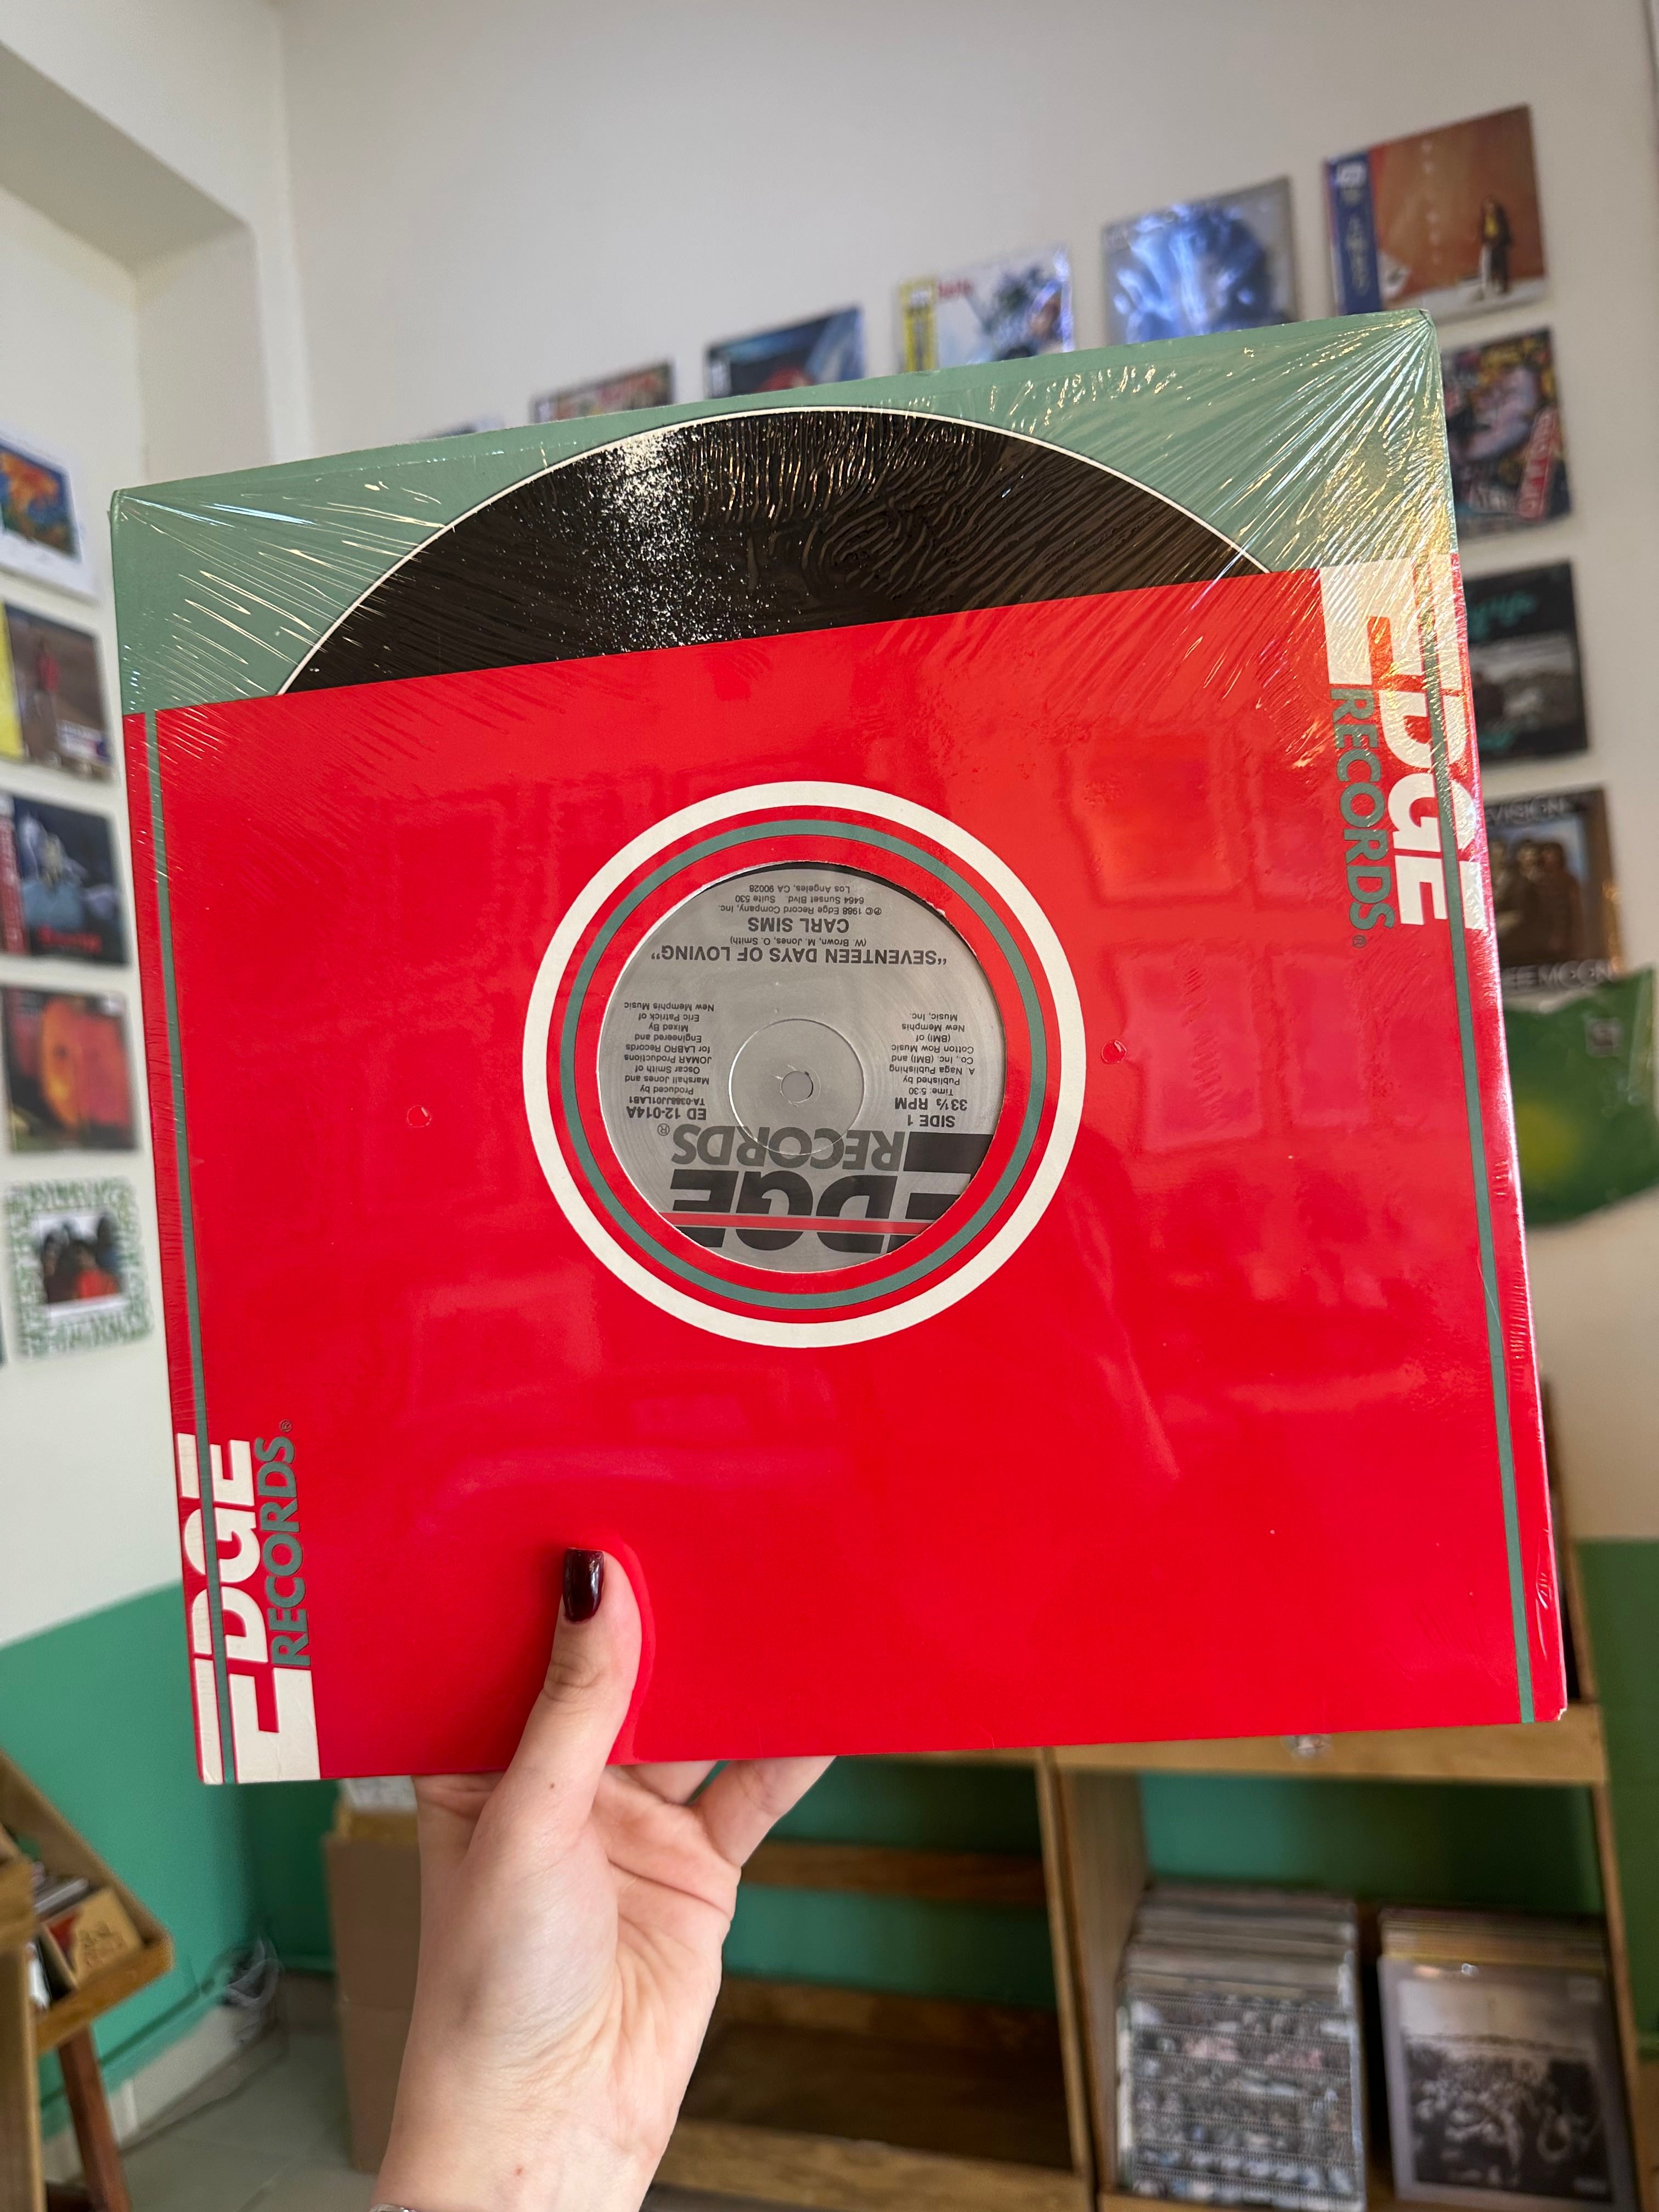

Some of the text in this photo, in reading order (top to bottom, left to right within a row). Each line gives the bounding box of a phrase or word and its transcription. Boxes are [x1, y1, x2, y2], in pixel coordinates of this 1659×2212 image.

[1319, 553, 1488, 931] EDGE
[793, 884, 831, 893] Angeles,
[737, 904, 780, 913] Company,
[783, 906, 814, 914] Record
[817, 905, 839, 915] Edge
[747, 917, 849, 933] CARL SIMS
[730, 936, 758, 945] Smith)
[774, 937, 802, 946] Jones,
[820, 937, 849, 947] Brown,
[853, 938, 867, 947] (W.
[651, 945, 947, 966] “SEVENTEEN DAYS OF LOVING”
[653, 1002, 692, 1011] Memphis
[929, 1012, 958, 1022] Music,
[648, 1022, 659, 1031] By
[902, 1023, 941, 1031] Memphis
[654, 1034, 702, 1042] Engineered
[927, 1034, 950, 1042] (BMI)
[625, 1044, 661, 1052] Records
[664, 1045, 696, 1053] LABRO
[624, 1054, 712, 1064] JOMAR Productions
[911, 1054, 934, 1063] (BMI)
[956, 1056, 973, 1064] Co.,
[889, 1064, 936, 1074] Publishing
[939, 1065, 962, 1074] Naga
[644, 1076, 669, 1084] Jones
[673, 1076, 709, 1085] Marshall
[903, 1075, 913, 1084] by
[640, 1084, 693, 1095] Produced by
[930, 1087, 953, 1096] Time:
[895, 1097, 928, 1110] RPM
[627, 1106, 707, 1120] ED 12-014A
[907, 1115, 956, 1128] SIDE 1
[177, 1432, 320, 1785] EDGE
